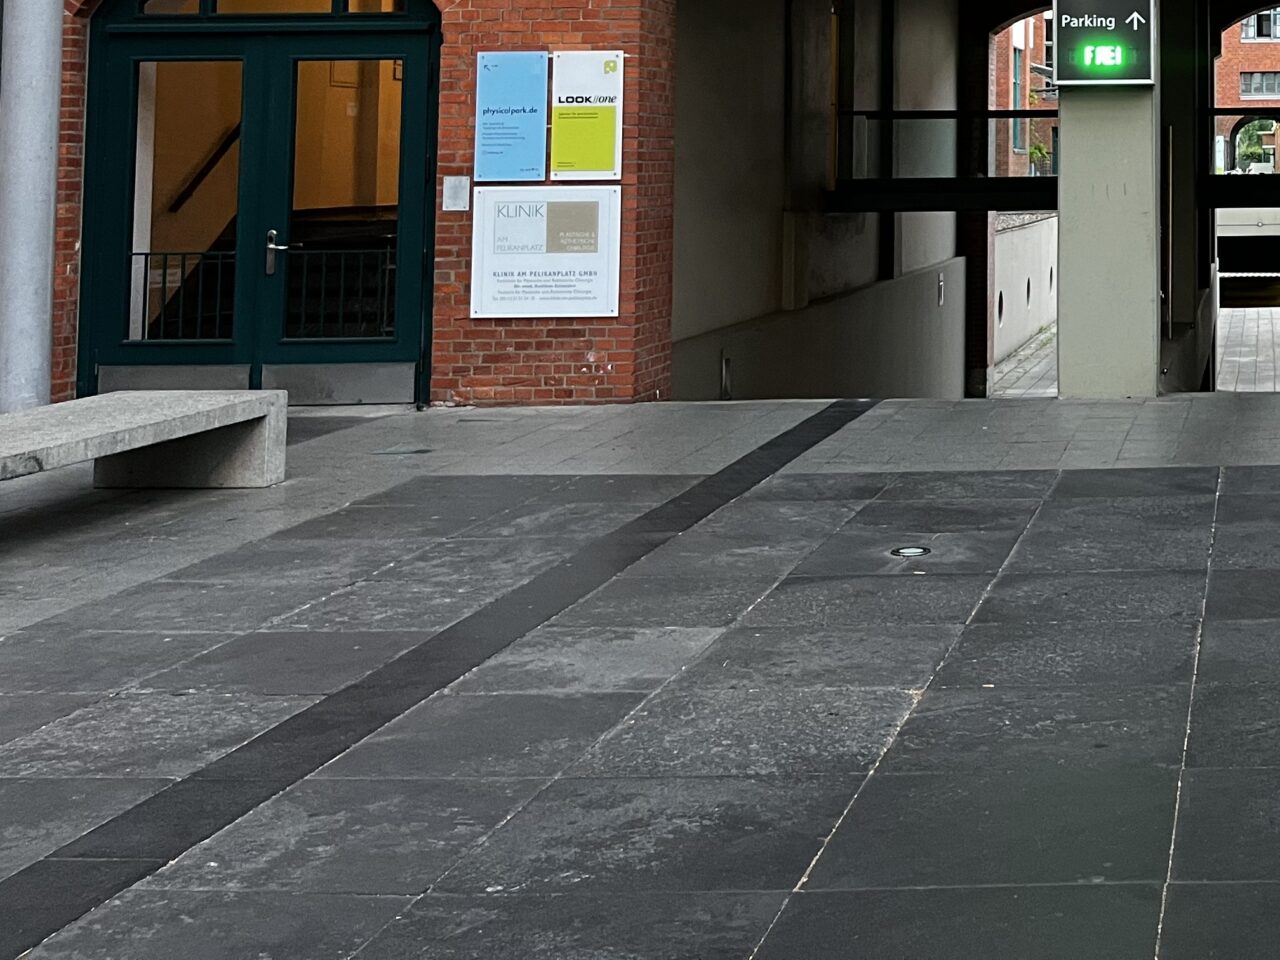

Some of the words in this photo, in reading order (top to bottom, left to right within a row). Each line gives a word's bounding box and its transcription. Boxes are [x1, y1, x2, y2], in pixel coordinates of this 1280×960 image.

[1061, 14, 1116, 30] Parking
[1083, 45, 1122, 66] FREI
[497, 204, 544, 218] KLINIK
